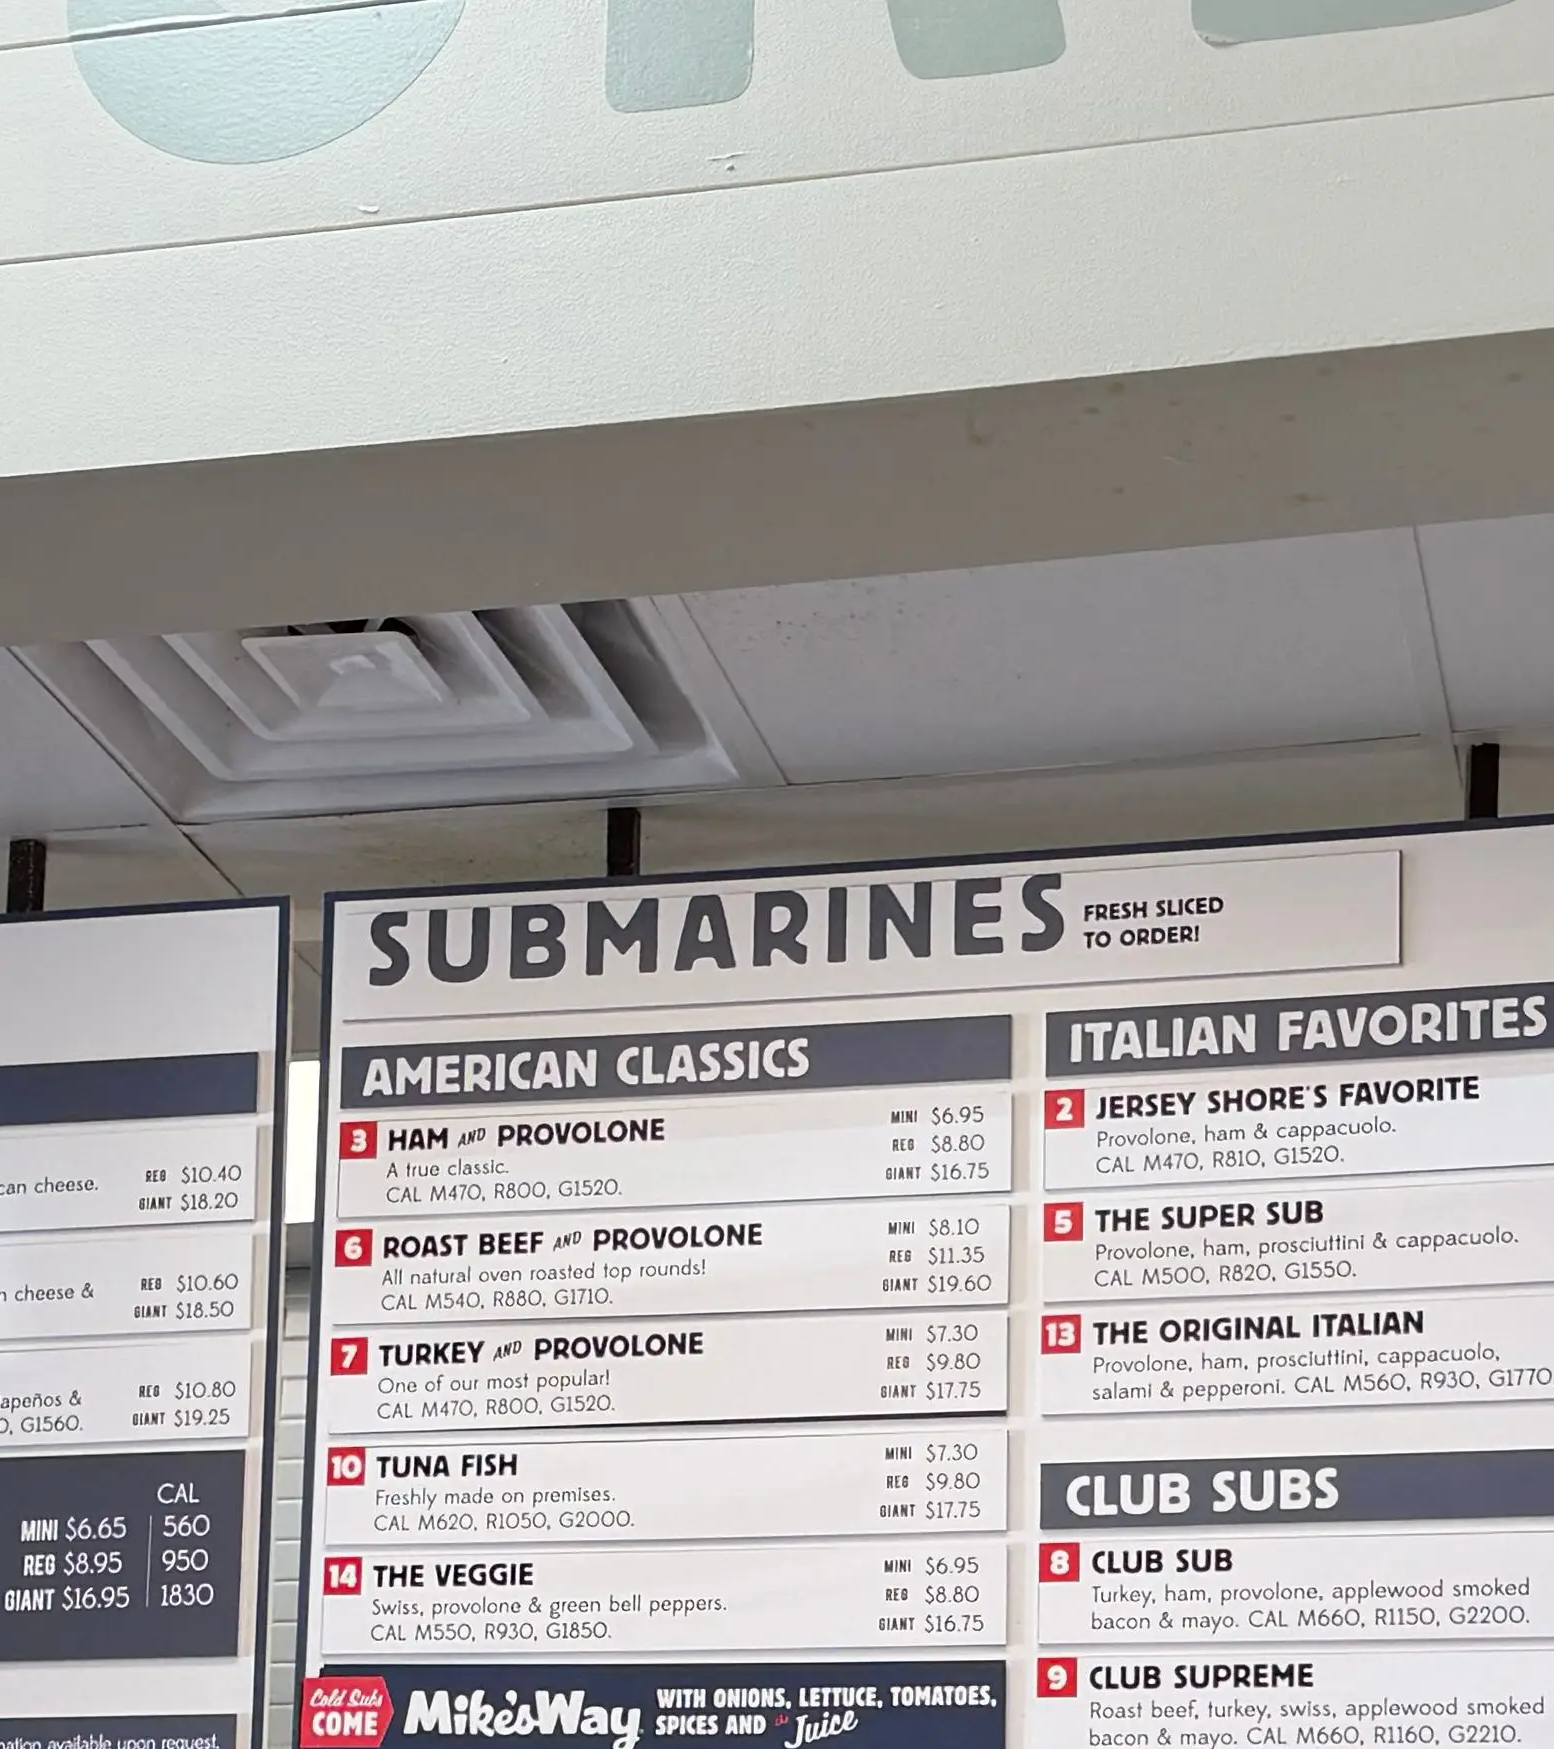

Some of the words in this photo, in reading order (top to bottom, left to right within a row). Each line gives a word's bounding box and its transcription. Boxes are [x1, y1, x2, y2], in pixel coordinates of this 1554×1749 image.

[370, 873, 1064, 990] SUBMARINES
[1070, 1014, 1256, 1062] ITALIAN
[1279, 996, 1547, 1051] FAVORITES
[363, 1050, 596, 1096] AMERICAN
[617, 1038, 809, 1084] CLASSICS
[891, 1110, 917, 1123] MINI
[932, 1106, 983, 1125] $6.95
[351, 1129, 366, 1152] 3
[389, 1128, 448, 1151] HAM
[458, 1128, 485, 1147] AND
[498, 1119, 664, 1147] PROVOLONE
[387, 1163, 397, 1178] A
[407, 1163, 439, 1177] true
[448, 1158, 508, 1176] classic.
[886, 1167, 921, 1180] GIANT
[931, 1162, 989, 1181] $16.75
[34, 1177, 98, 1193] cheese.
[1067, 1473, 1190, 1516] CLUB
[1213, 1468, 1338, 1512] SUBS
[1048, 1665, 1067, 1689] 9
[1090, 1666, 1160, 1689] CLUB
[1175, 1664, 1313, 1688] SUPREME
[310, 1689, 347, 1707] Cold
[347, 1689, 383, 1706] Subs
[657, 1689, 706, 1708] WITH
[714, 1688, 791, 1709] ONIONS,
[800, 1687, 882, 1708] LETTUCE,
[891, 1685, 996, 1706] TOMATOES,
[1091, 1702, 1142, 1719] Roast
[1152, 1699, 1198, 1719] beef,
[1209, 1699, 1271, 1723] turkey,
[1281, 1701, 1336, 1718] swiss,
[1346, 1697, 1457, 1721] applewood
[1468, 1696, 1544, 1715] smoked
[313, 1712, 377, 1736] COME
[656, 1715, 718, 1735] SPICES
[725, 1715, 766, 1734] AND
[785, 1710, 858, 1748] Juice
